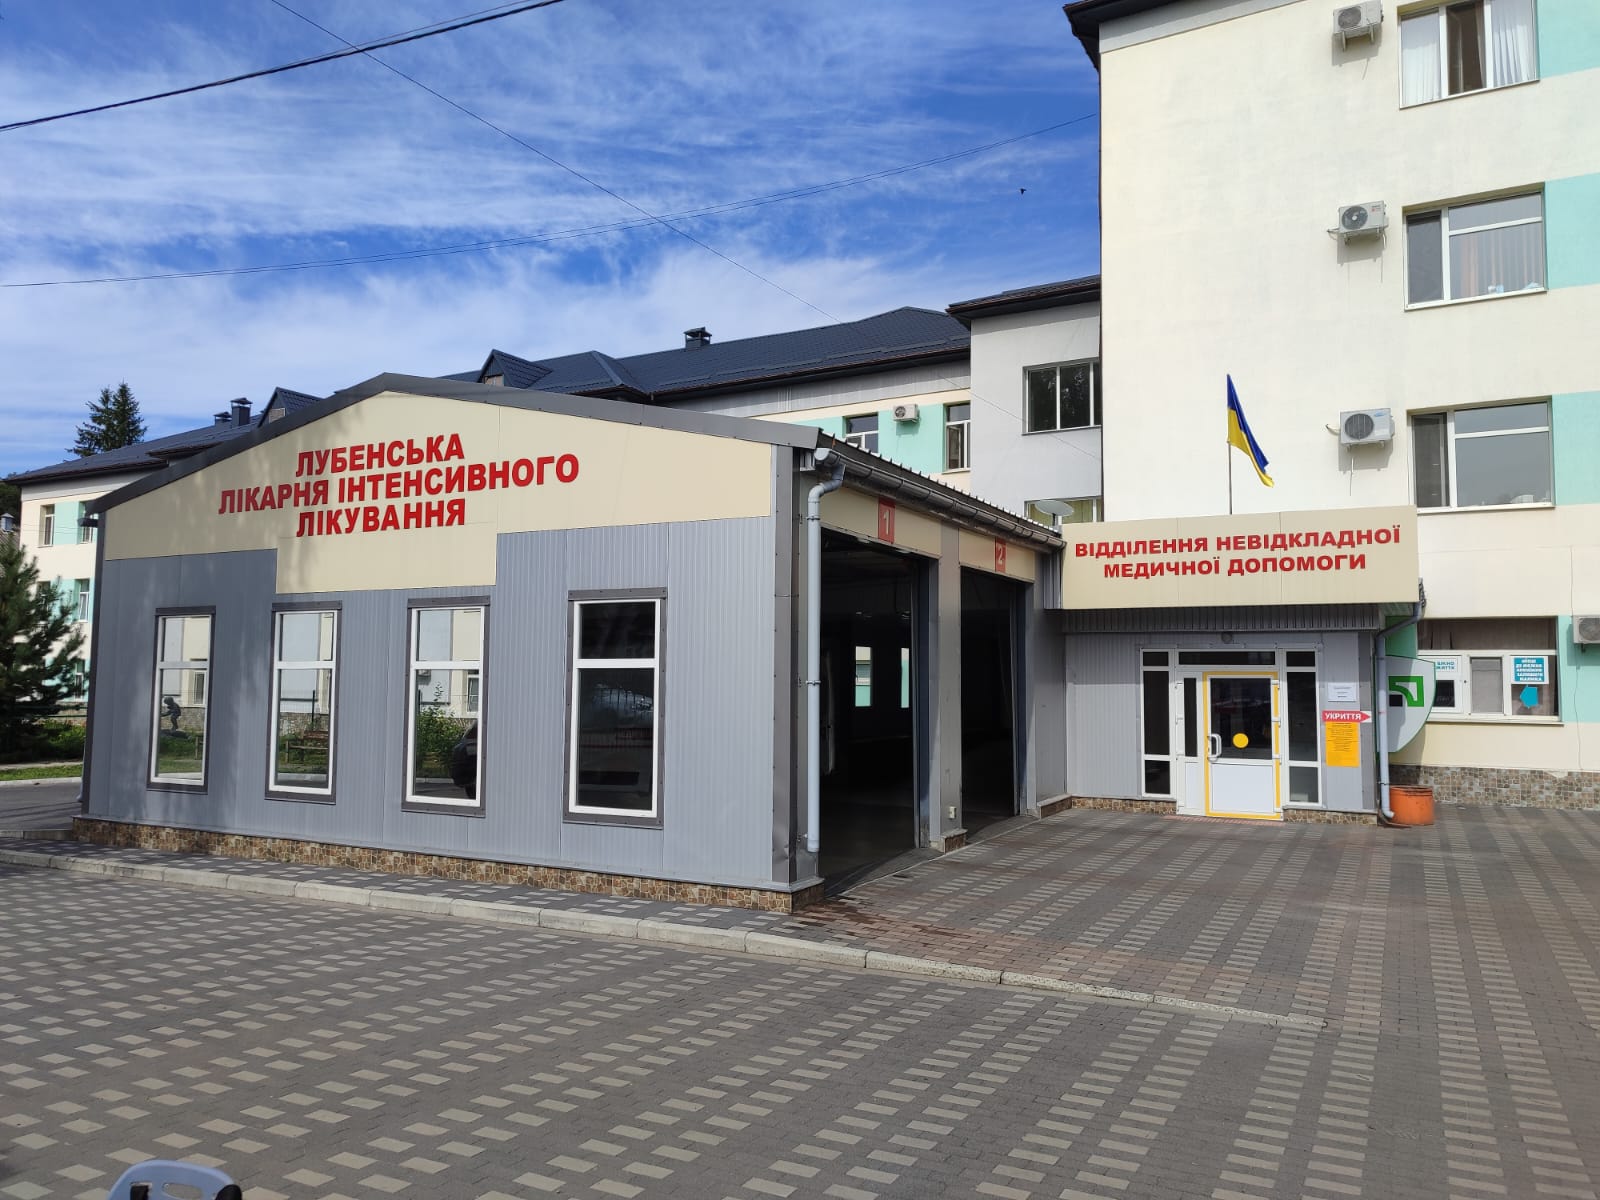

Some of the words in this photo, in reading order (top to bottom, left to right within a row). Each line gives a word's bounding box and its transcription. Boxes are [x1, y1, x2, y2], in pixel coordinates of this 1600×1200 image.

[295, 433, 465, 478] ЛУБЕНСЬКА
[218, 478, 329, 514] ЛІКАРНЯ
[338, 453, 580, 504] ІНТЕНСИВНОГО
[295, 498, 466, 538] ЛІКУВАННЯ
[883, 508, 890, 536] 1
[1075, 537, 1208, 559] ВІДДІЛЕННЯ
[1216, 525, 1401, 552] НЕВІДКЛАДНОЇ
[1104, 557, 1221, 580] МЕДИЧНОЇ
[1227, 554, 1367, 577] ДОПОМОГИ
[1324, 712, 1362, 720] УКРИТТЯ
